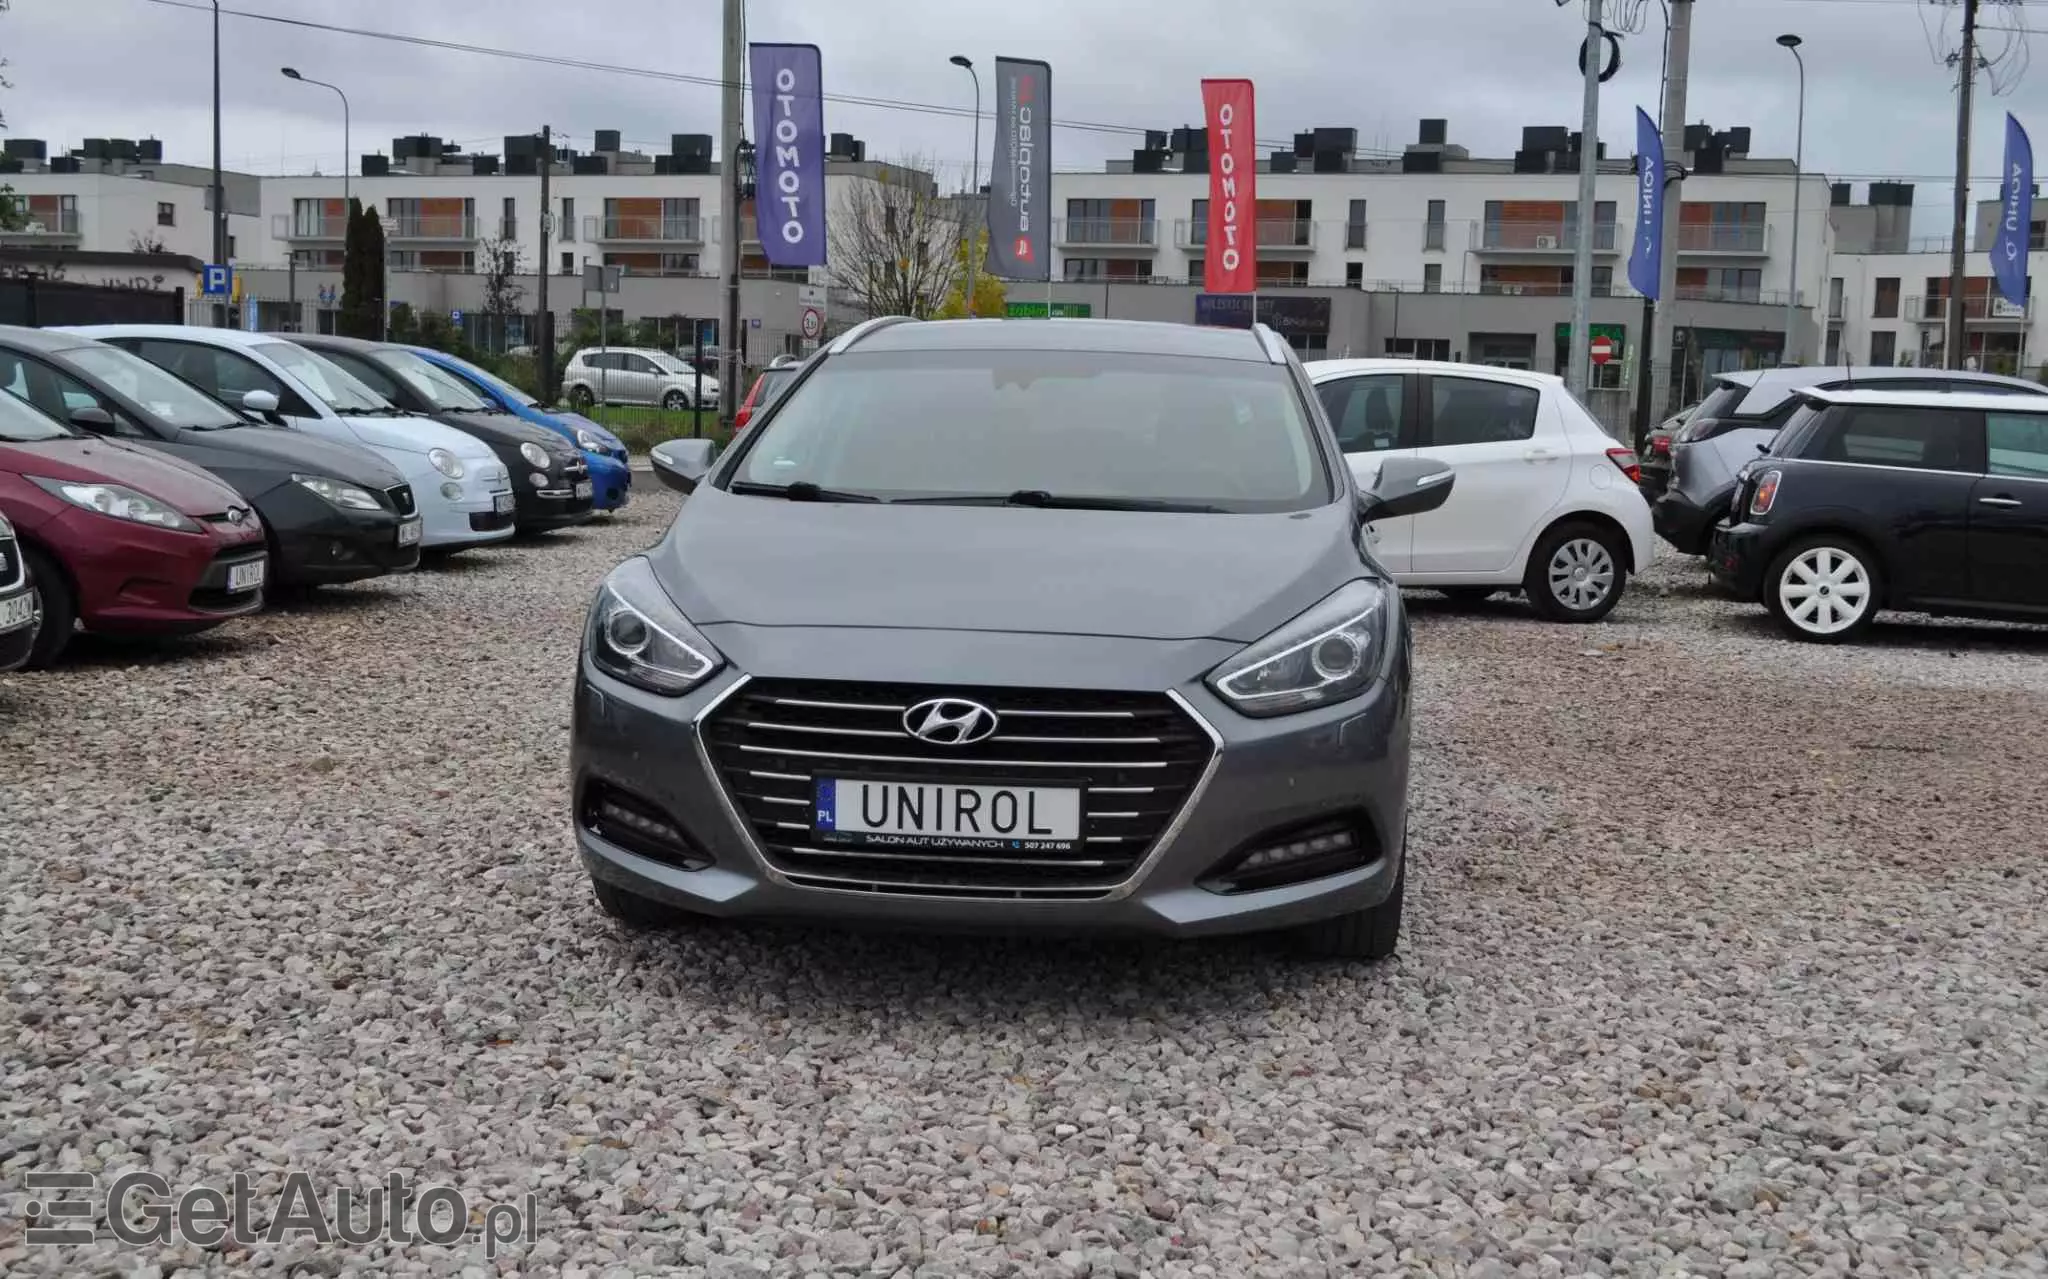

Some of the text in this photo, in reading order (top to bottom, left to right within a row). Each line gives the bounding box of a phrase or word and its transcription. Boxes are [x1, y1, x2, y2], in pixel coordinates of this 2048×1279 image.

[775, 67, 804, 244] OTOMOTO
[1219, 103, 1240, 272] OTOMOTO
[209, 268, 226, 291] P
[817, 810, 833, 823] PL
[862, 784, 1053, 835] UNIROL
[865, 834, 905, 844] SALON
[906, 836, 929, 845] AUT
[1025, 840, 1039, 849] 507
[1040, 841, 1054, 850] 247
